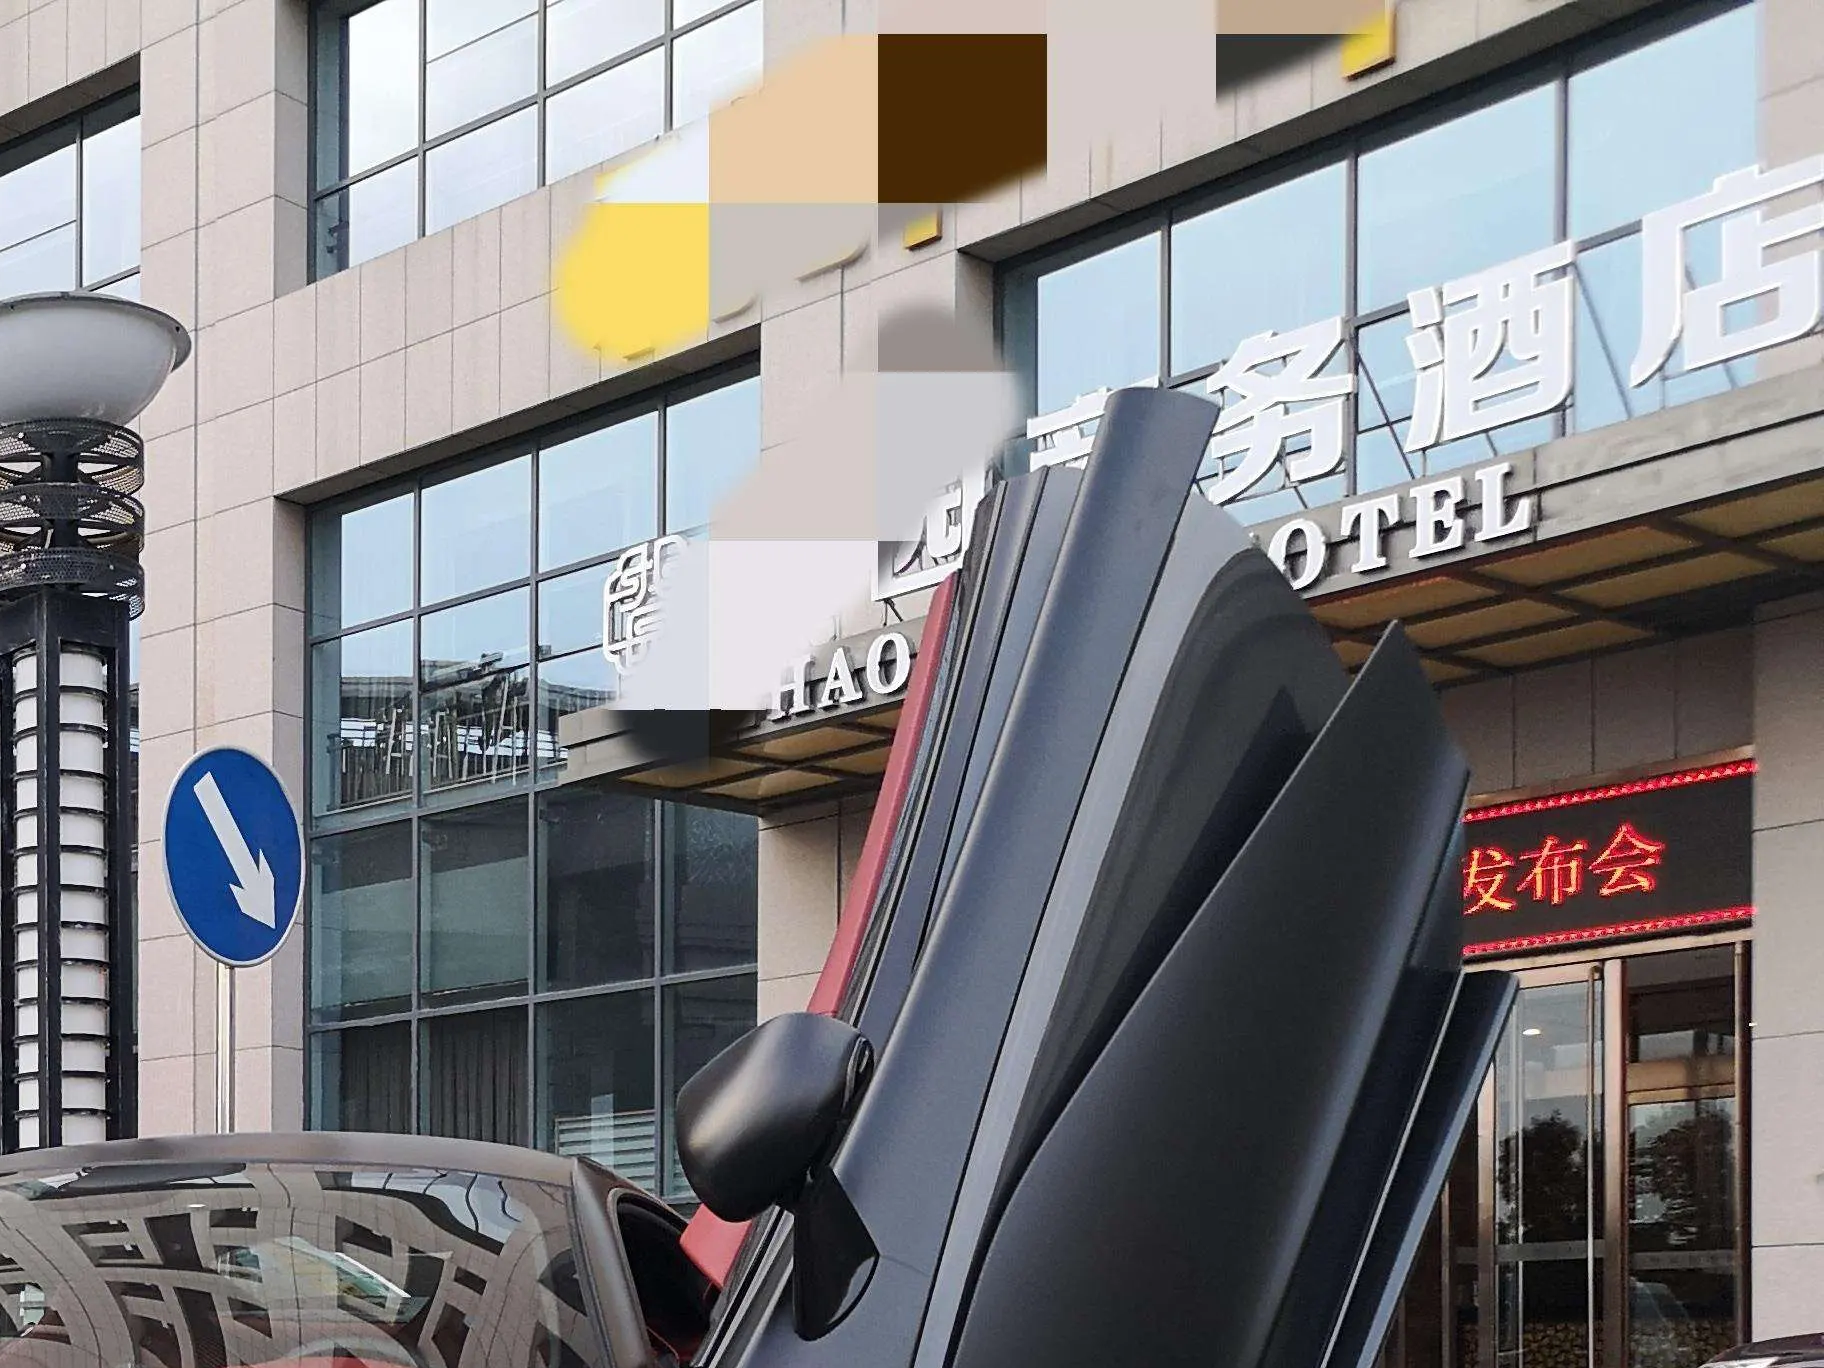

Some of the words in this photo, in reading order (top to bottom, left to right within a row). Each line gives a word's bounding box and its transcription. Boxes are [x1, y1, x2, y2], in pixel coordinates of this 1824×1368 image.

[1248, 461, 1531, 591] OTEL
[1463, 822, 1665, 914] 发布会
